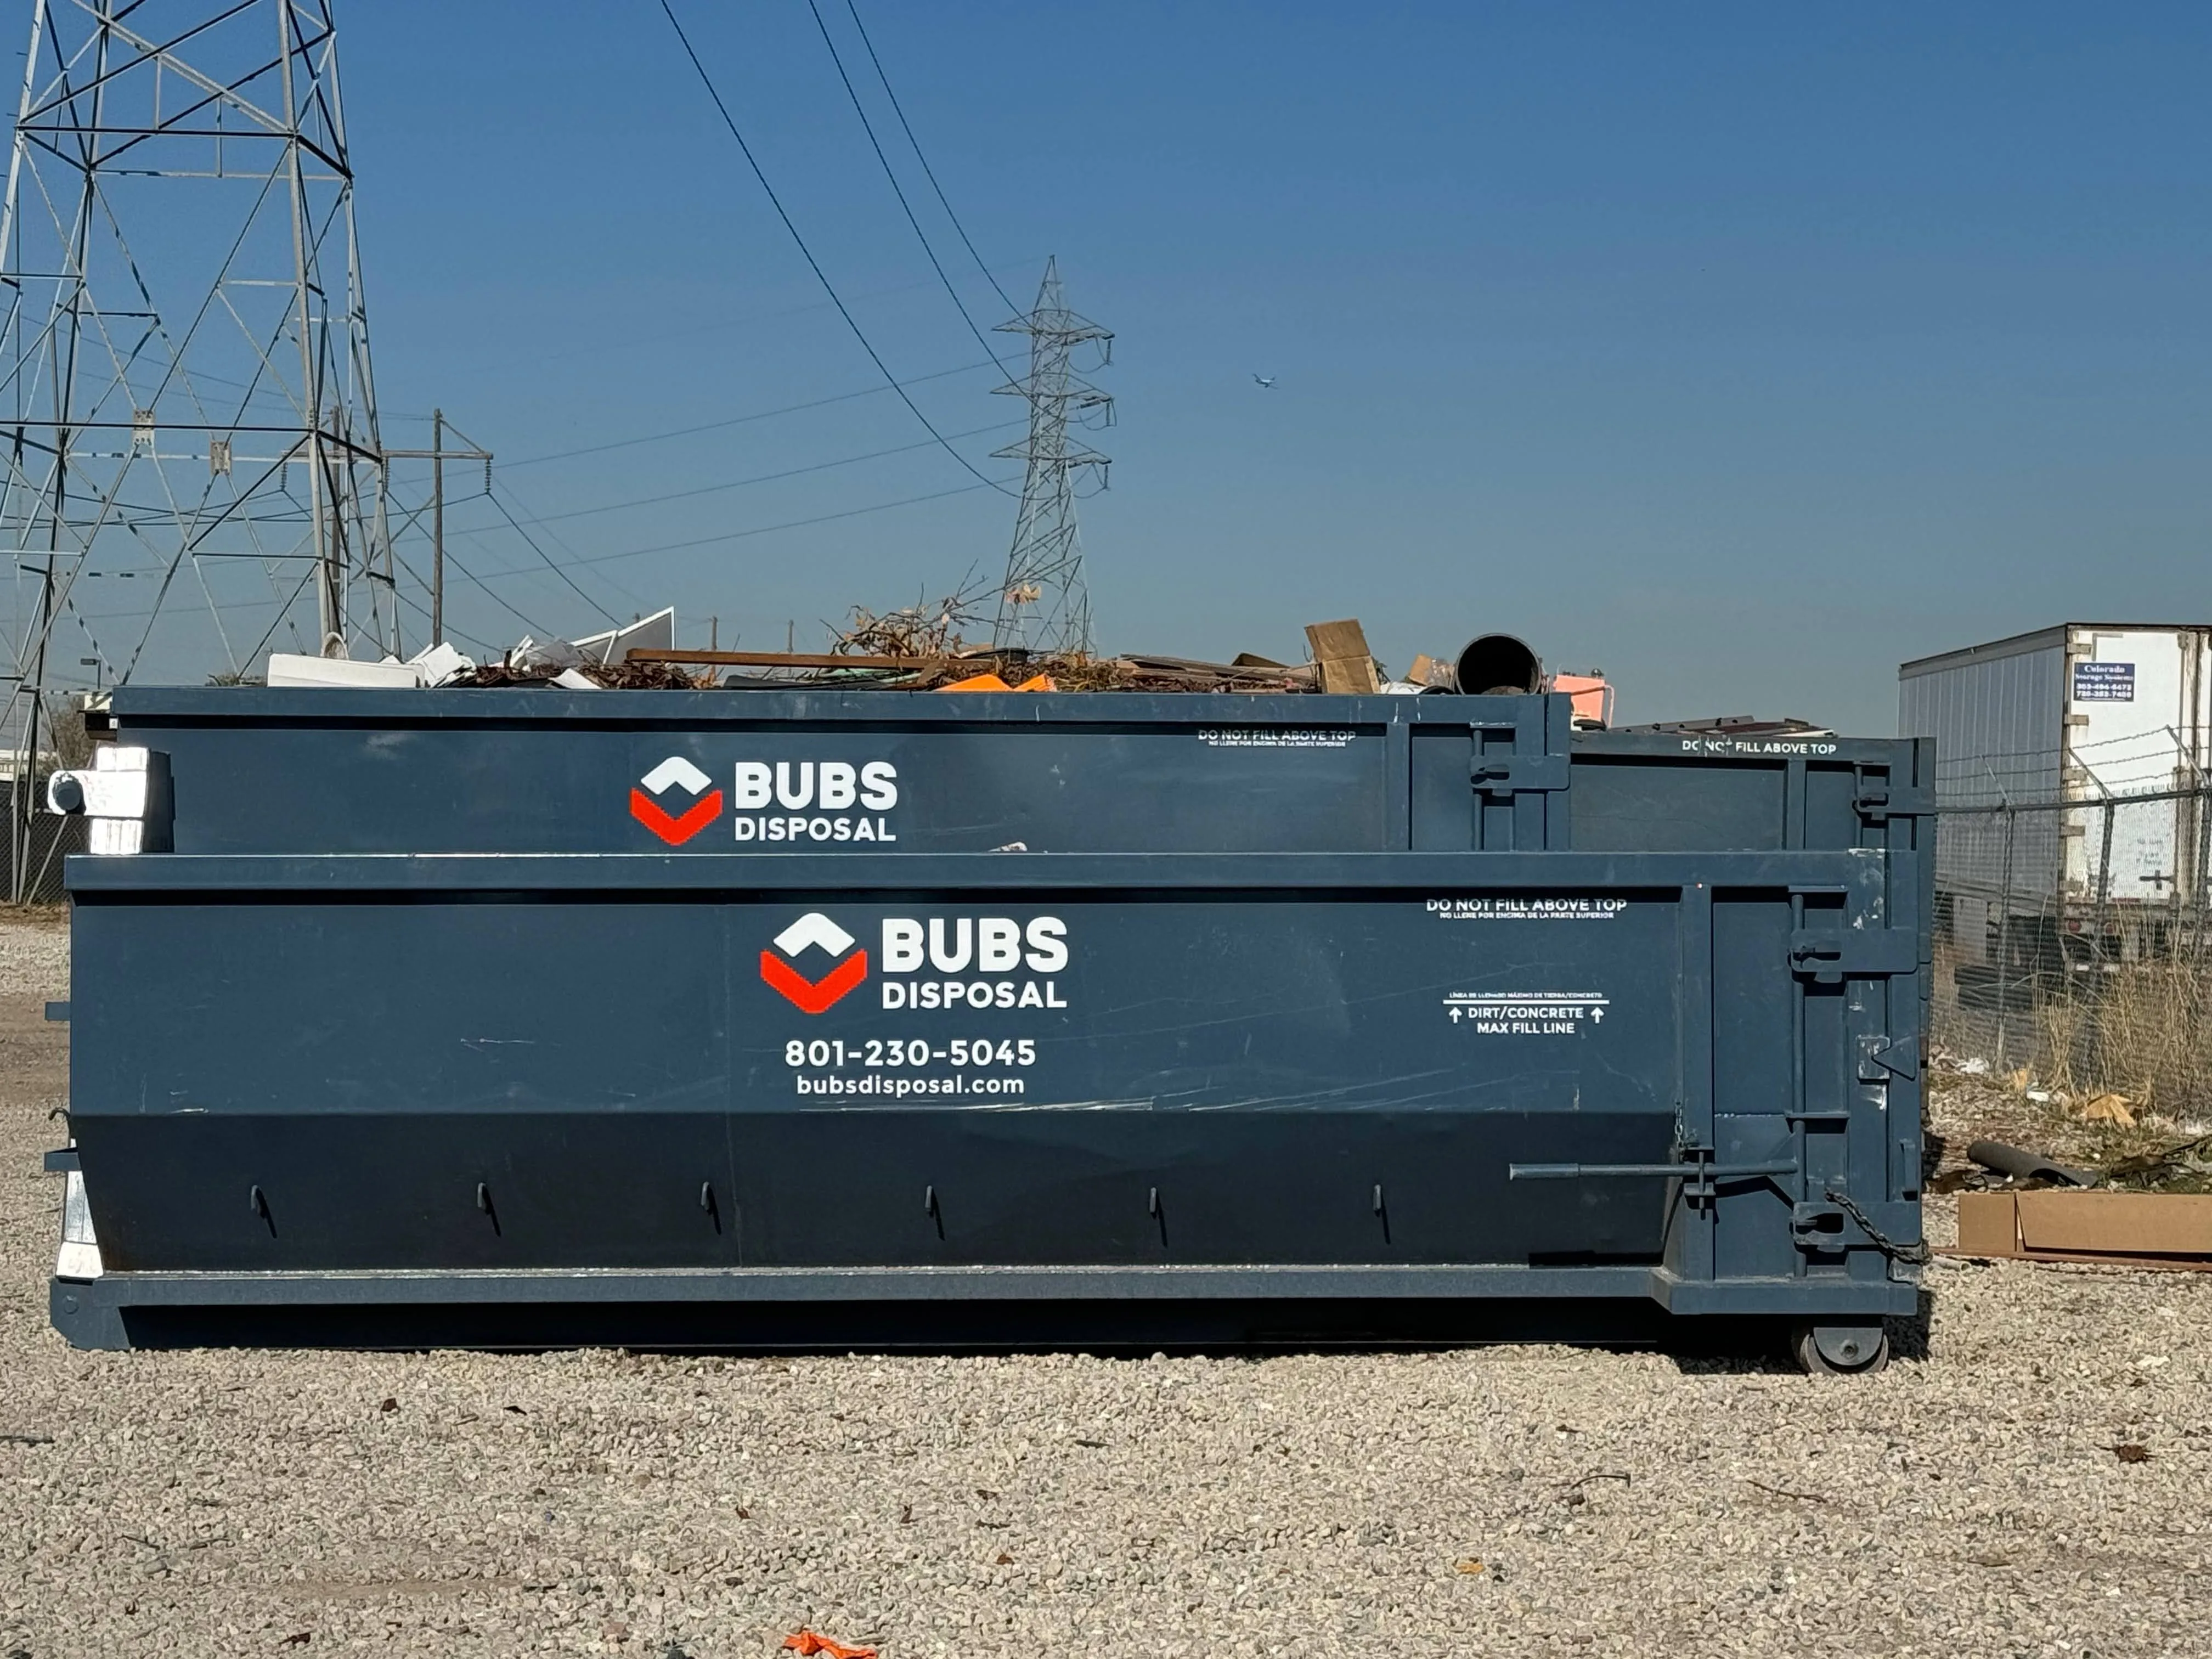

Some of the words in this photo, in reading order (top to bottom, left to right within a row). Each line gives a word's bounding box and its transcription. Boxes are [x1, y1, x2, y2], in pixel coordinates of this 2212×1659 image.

[2084, 665, 2125, 673] Colorado
[1198, 730, 1218, 740] DO
[1221, 730, 1249, 740] NOT
[1252, 730, 1279, 740] FILL
[1282, 730, 1327, 741] ABOVE
[1329, 730, 1356, 741] TOP
[1735, 741, 1760, 753] FILL
[1763, 743, 1808, 754] ABOVE
[1810, 744, 1837, 755] TOP
[735, 761, 898, 810] BUBS
[735, 817, 896, 842] DISPOSAL
[1426, 899, 1451, 911] DO
[1455, 899, 1491, 911] NOT
[1496, 899, 1528, 911] FILL
[1532, 898, 1589, 911] ABOVE
[1594, 898, 1627, 911] TOP
[882, 916, 1069, 973] BUBS
[882, 981, 1068, 1009] DISPOSAL
[1468, 1006, 1584, 1020] DIRT/CONCRETE
[1477, 1023, 1509, 1034] MAX
[1513, 1023, 1540, 1034] FILL
[1543, 1023, 1575, 1034] LINE
[785, 1040, 1036, 1067] 801-230-5045
[797, 1075, 1025, 1098] bubsdisposal.com
